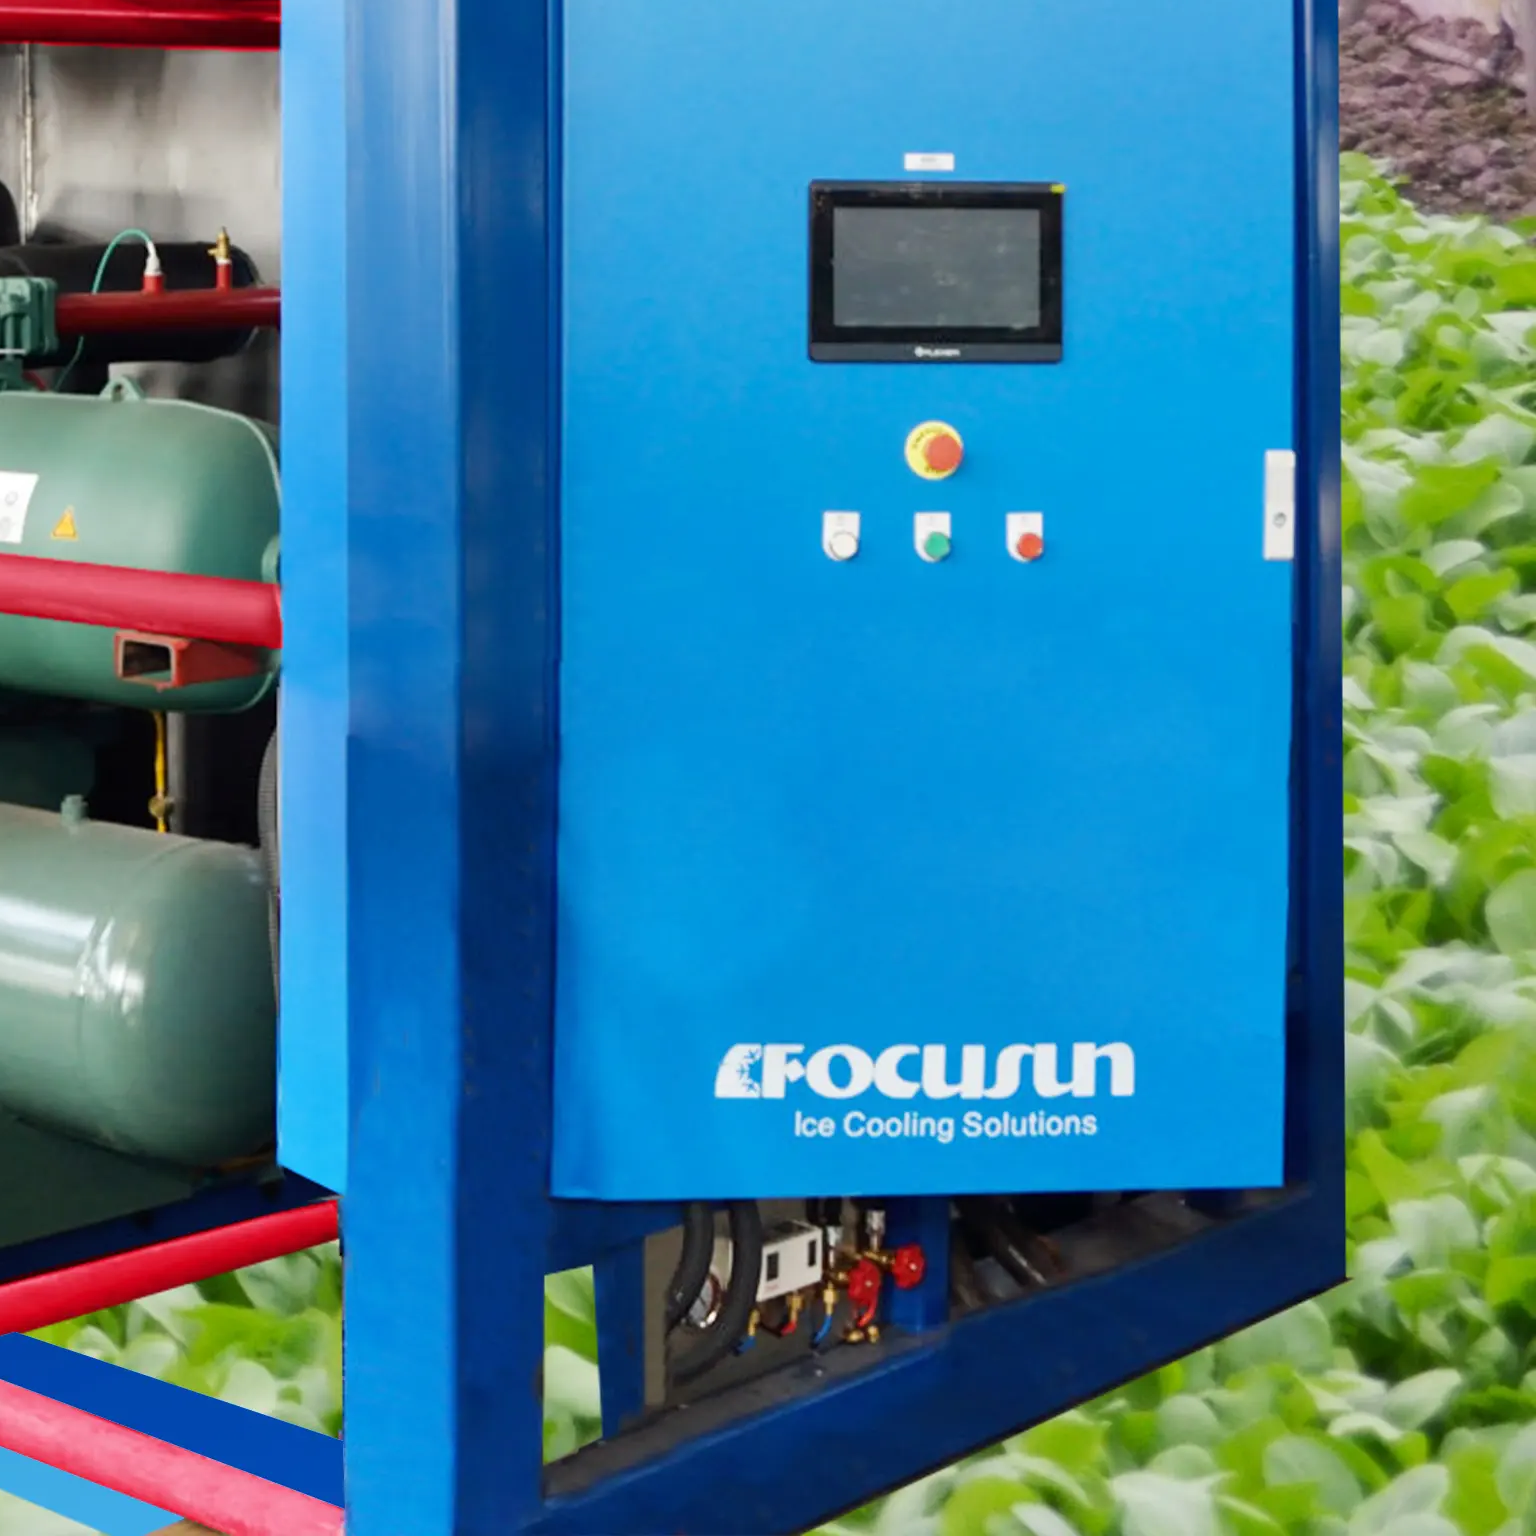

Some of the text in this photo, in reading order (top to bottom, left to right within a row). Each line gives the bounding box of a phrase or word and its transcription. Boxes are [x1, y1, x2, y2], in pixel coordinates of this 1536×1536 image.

[794, 1110, 1098, 1144] Ice Cooling Solutions
